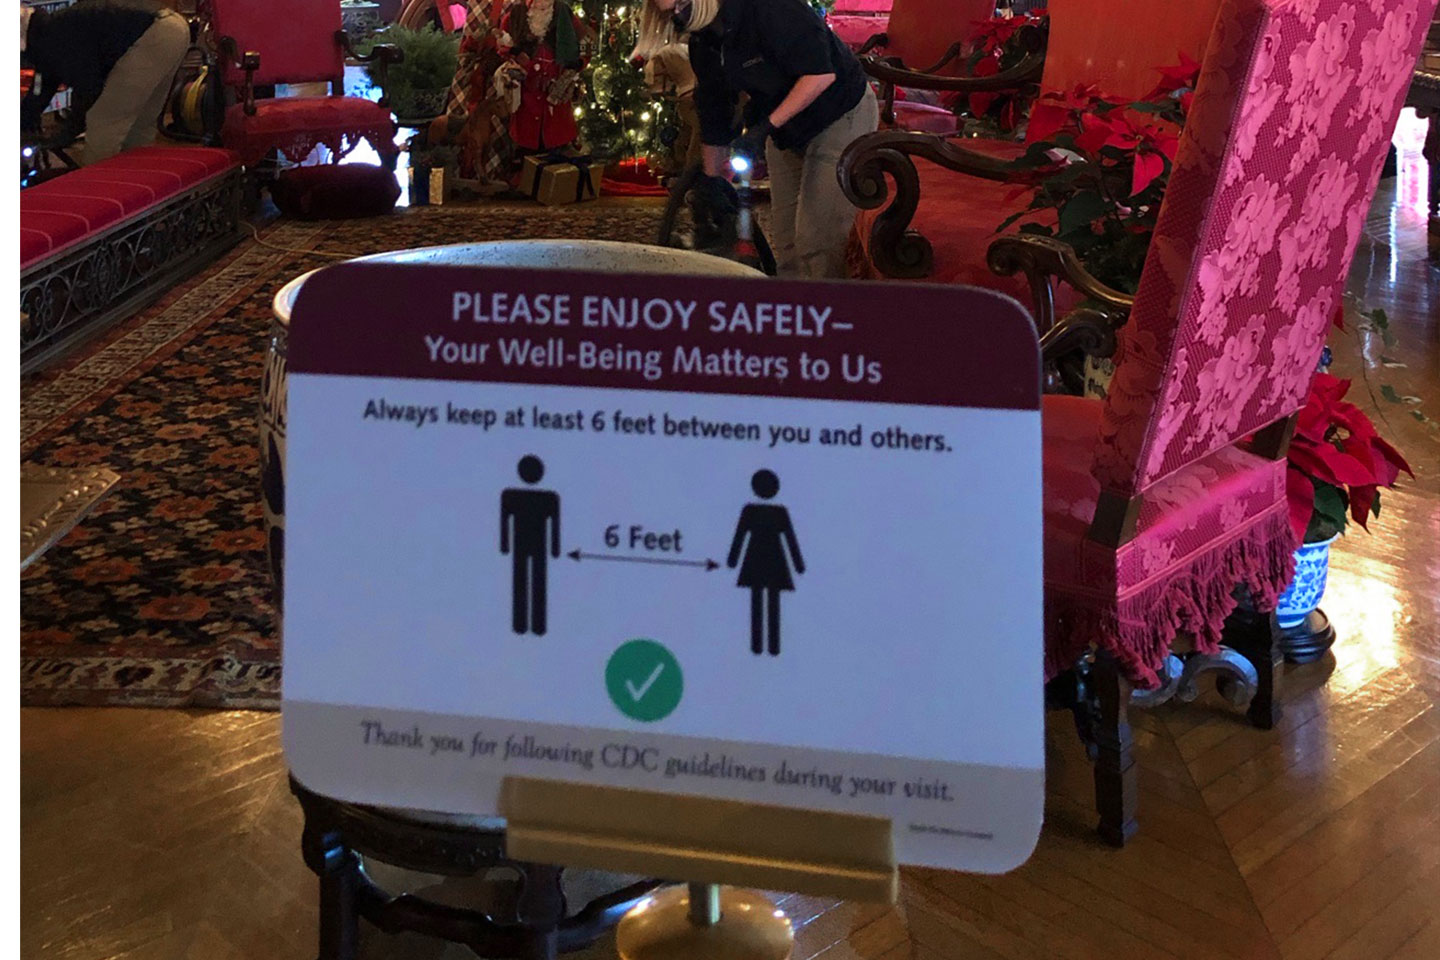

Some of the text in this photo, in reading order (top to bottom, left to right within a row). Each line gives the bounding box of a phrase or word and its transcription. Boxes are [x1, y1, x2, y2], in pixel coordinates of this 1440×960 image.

[452, 291, 570, 325] PLEASE
[582, 296, 697, 332] ENJOY
[424, 336, 883, 385] Your Well-Being Matters to Us
[363, 398, 953, 453] Always keep at least 6 feet between you and others.
[604, 524, 683, 553] 6 Feet
[361, 719, 956, 803] Thank you for following CDC guidelines during your visit.
